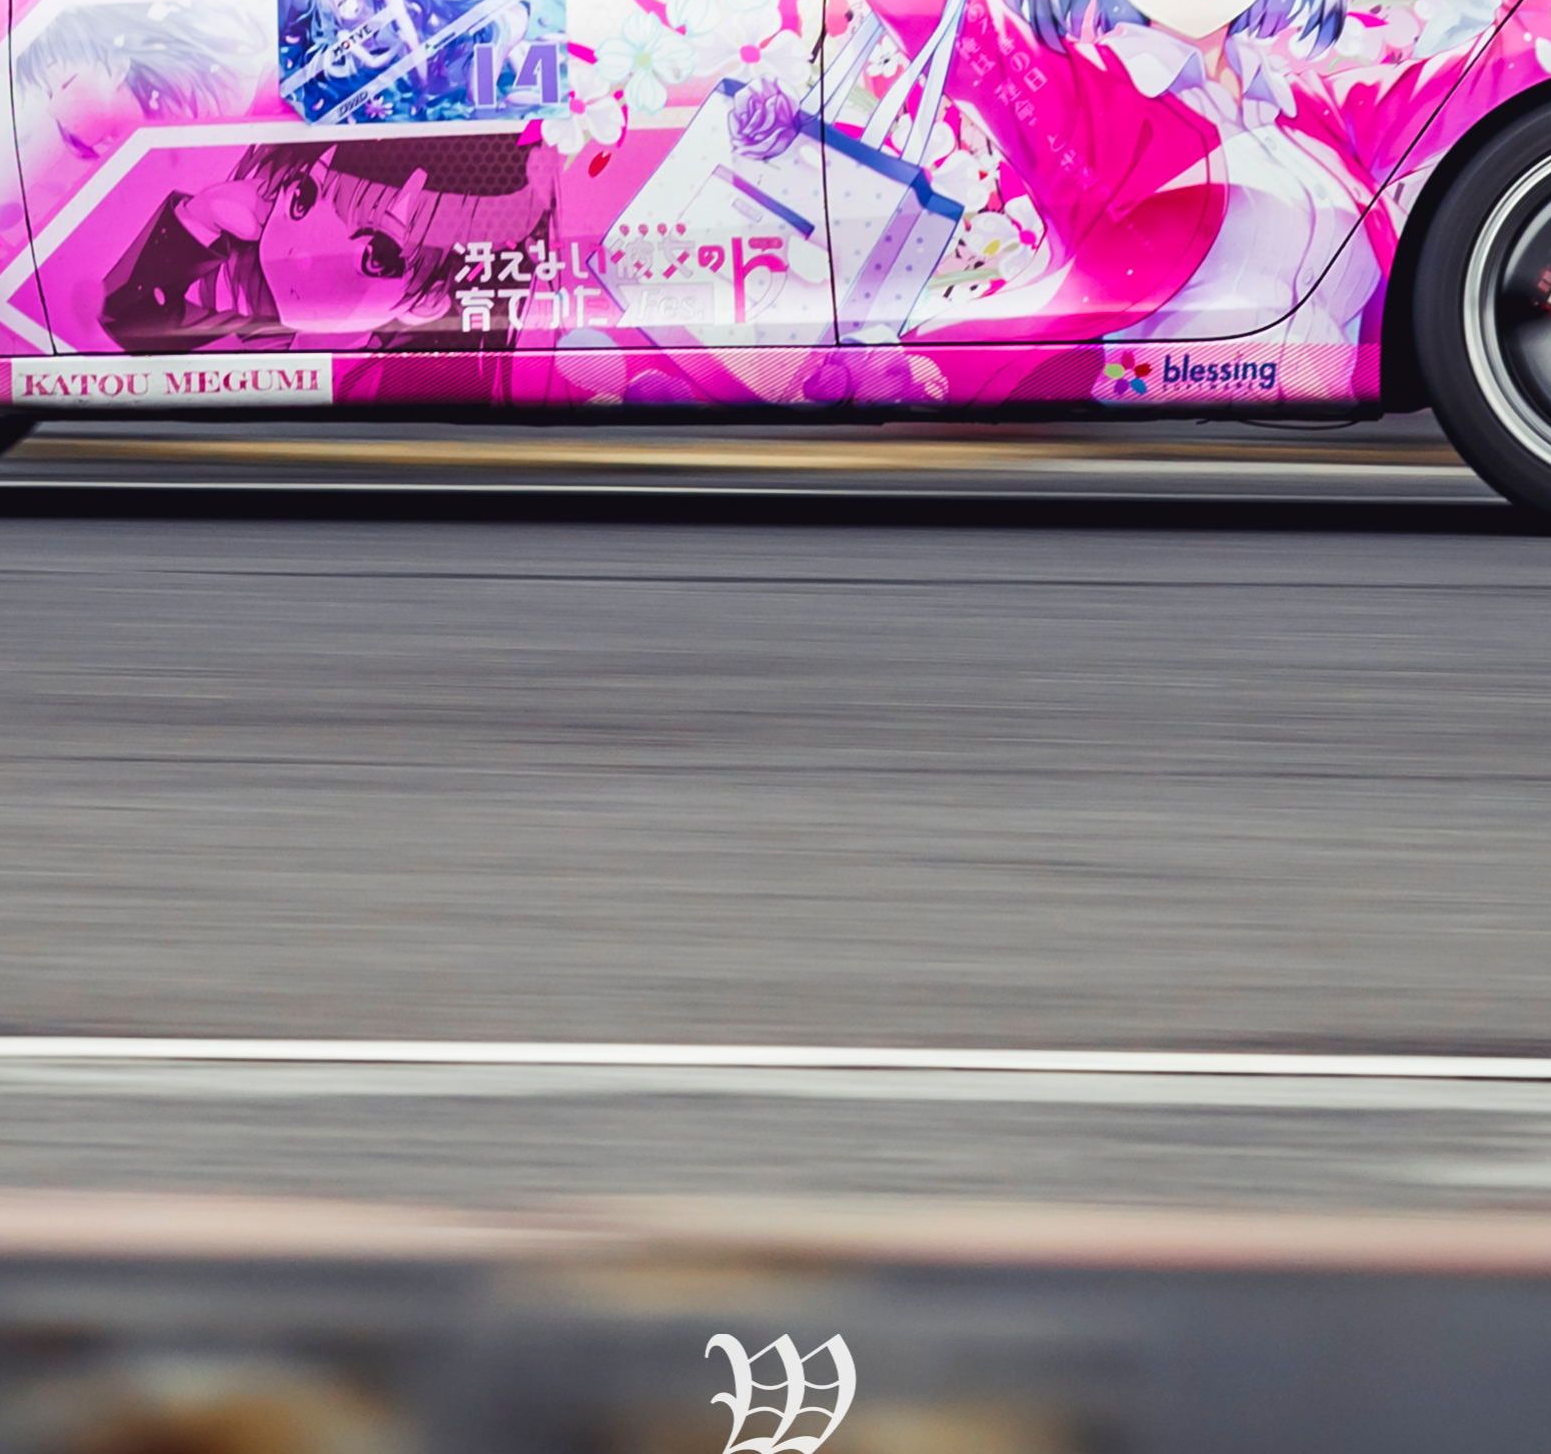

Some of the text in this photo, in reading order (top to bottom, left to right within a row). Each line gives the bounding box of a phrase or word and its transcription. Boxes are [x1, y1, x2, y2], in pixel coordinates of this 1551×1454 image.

[22, 368, 323, 397] KATOU MEGUMI
[1163, 353, 1277, 390] blessing
